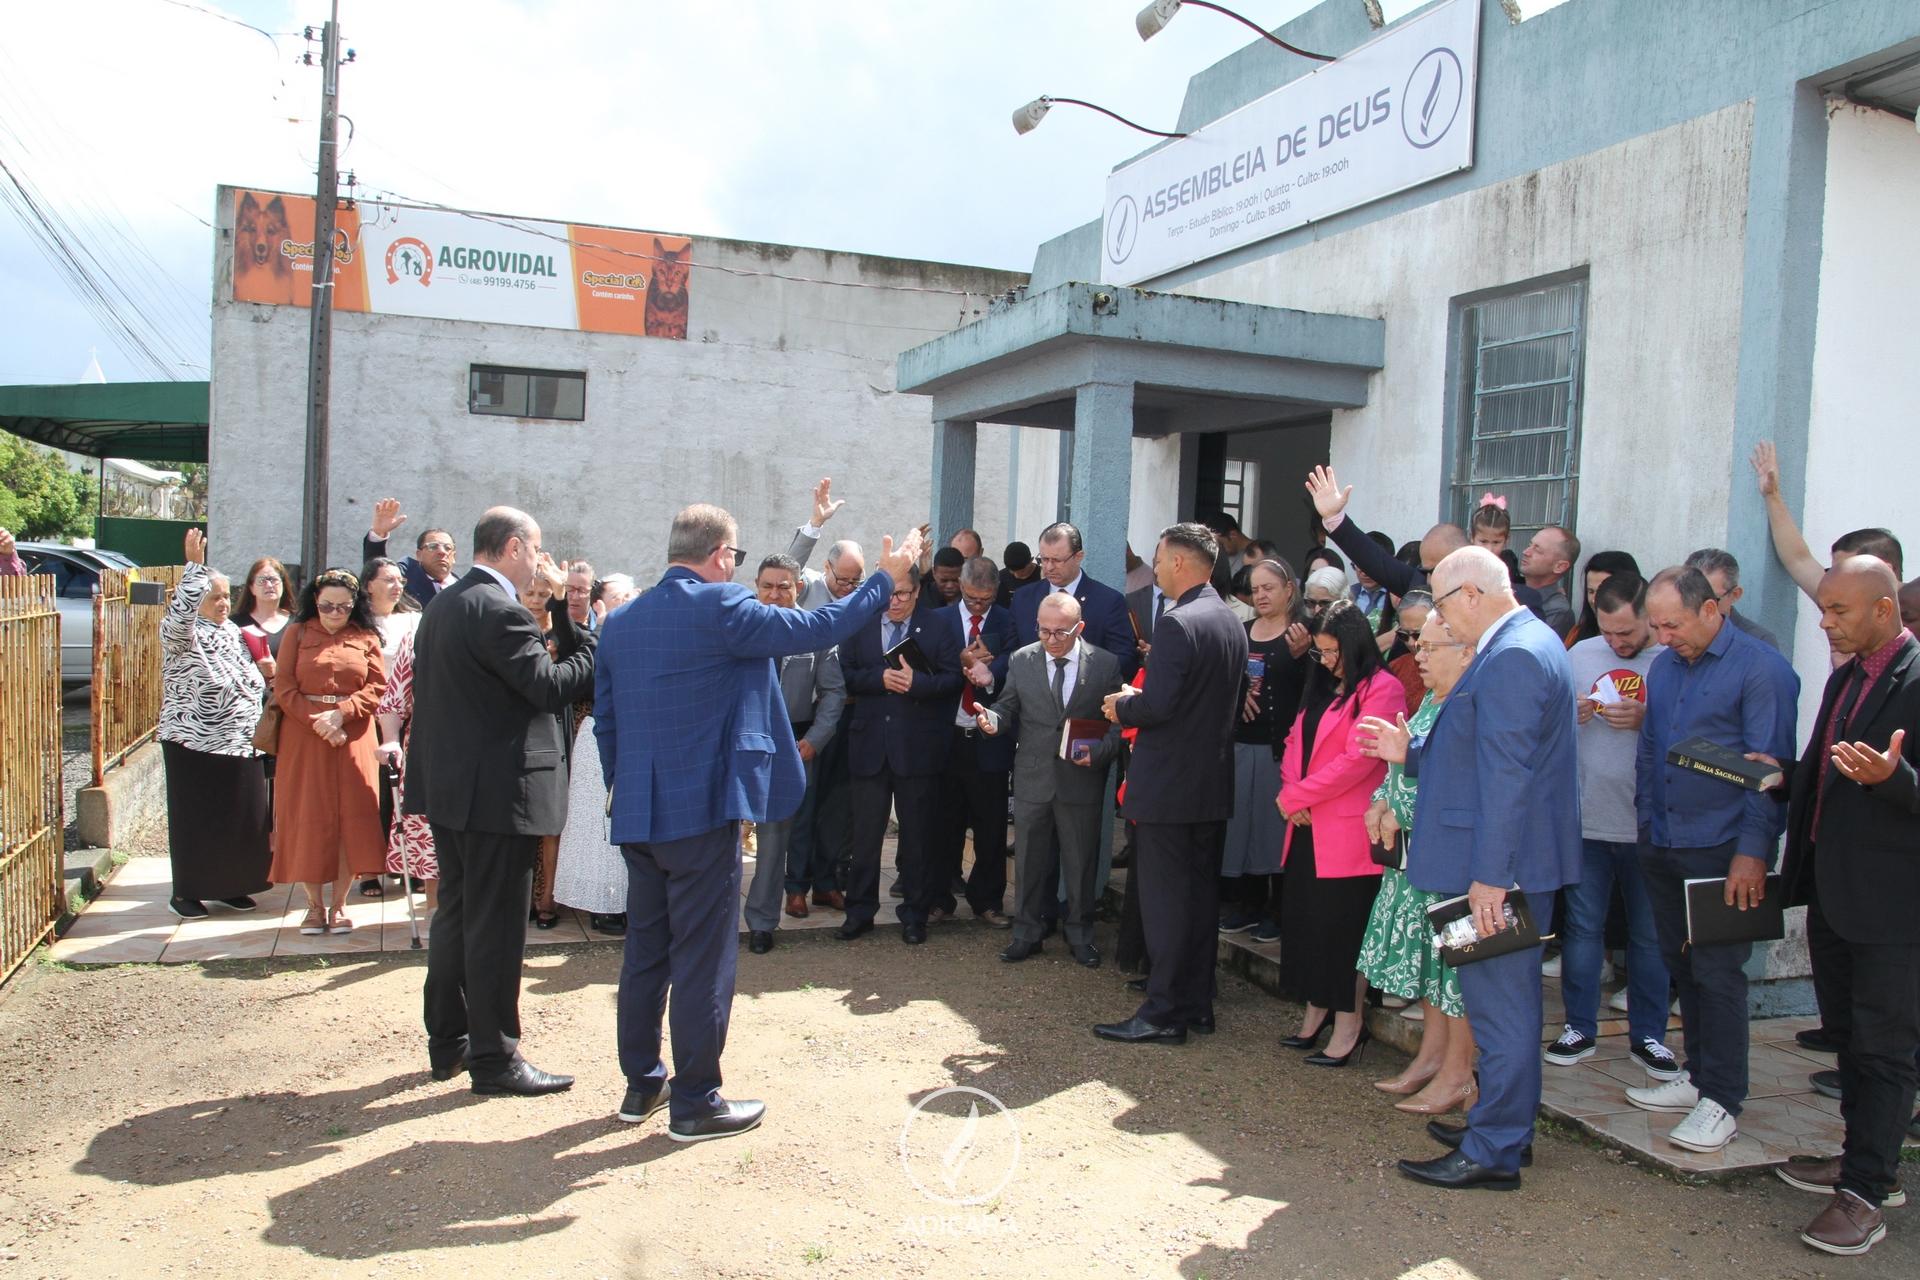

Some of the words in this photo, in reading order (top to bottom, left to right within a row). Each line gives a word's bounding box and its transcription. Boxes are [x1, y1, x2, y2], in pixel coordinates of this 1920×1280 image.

[1142, 145, 1266, 223] ASSEMBLEIA
[1276, 125, 1307, 167] DE
[1318, 87, 1391, 149] DEUS
[1189, 215, 1210, 230] Estudo
[1235, 193, 1258, 212] 19:00h
[1264, 183, 1290, 201] Quinta
[1297, 171, 1321, 188] Culto:
[1322, 157, 1349, 177] 19:00h
[1209, 220, 1240, 238] Domingo
[1246, 208, 1267, 225] Culto:
[1268, 199, 1291, 217] 18:30h
[438, 245, 557, 277] AGROVIDAL
[483, 276, 536, 290] 99199.4756
[584, 271, 624, 287] Special
